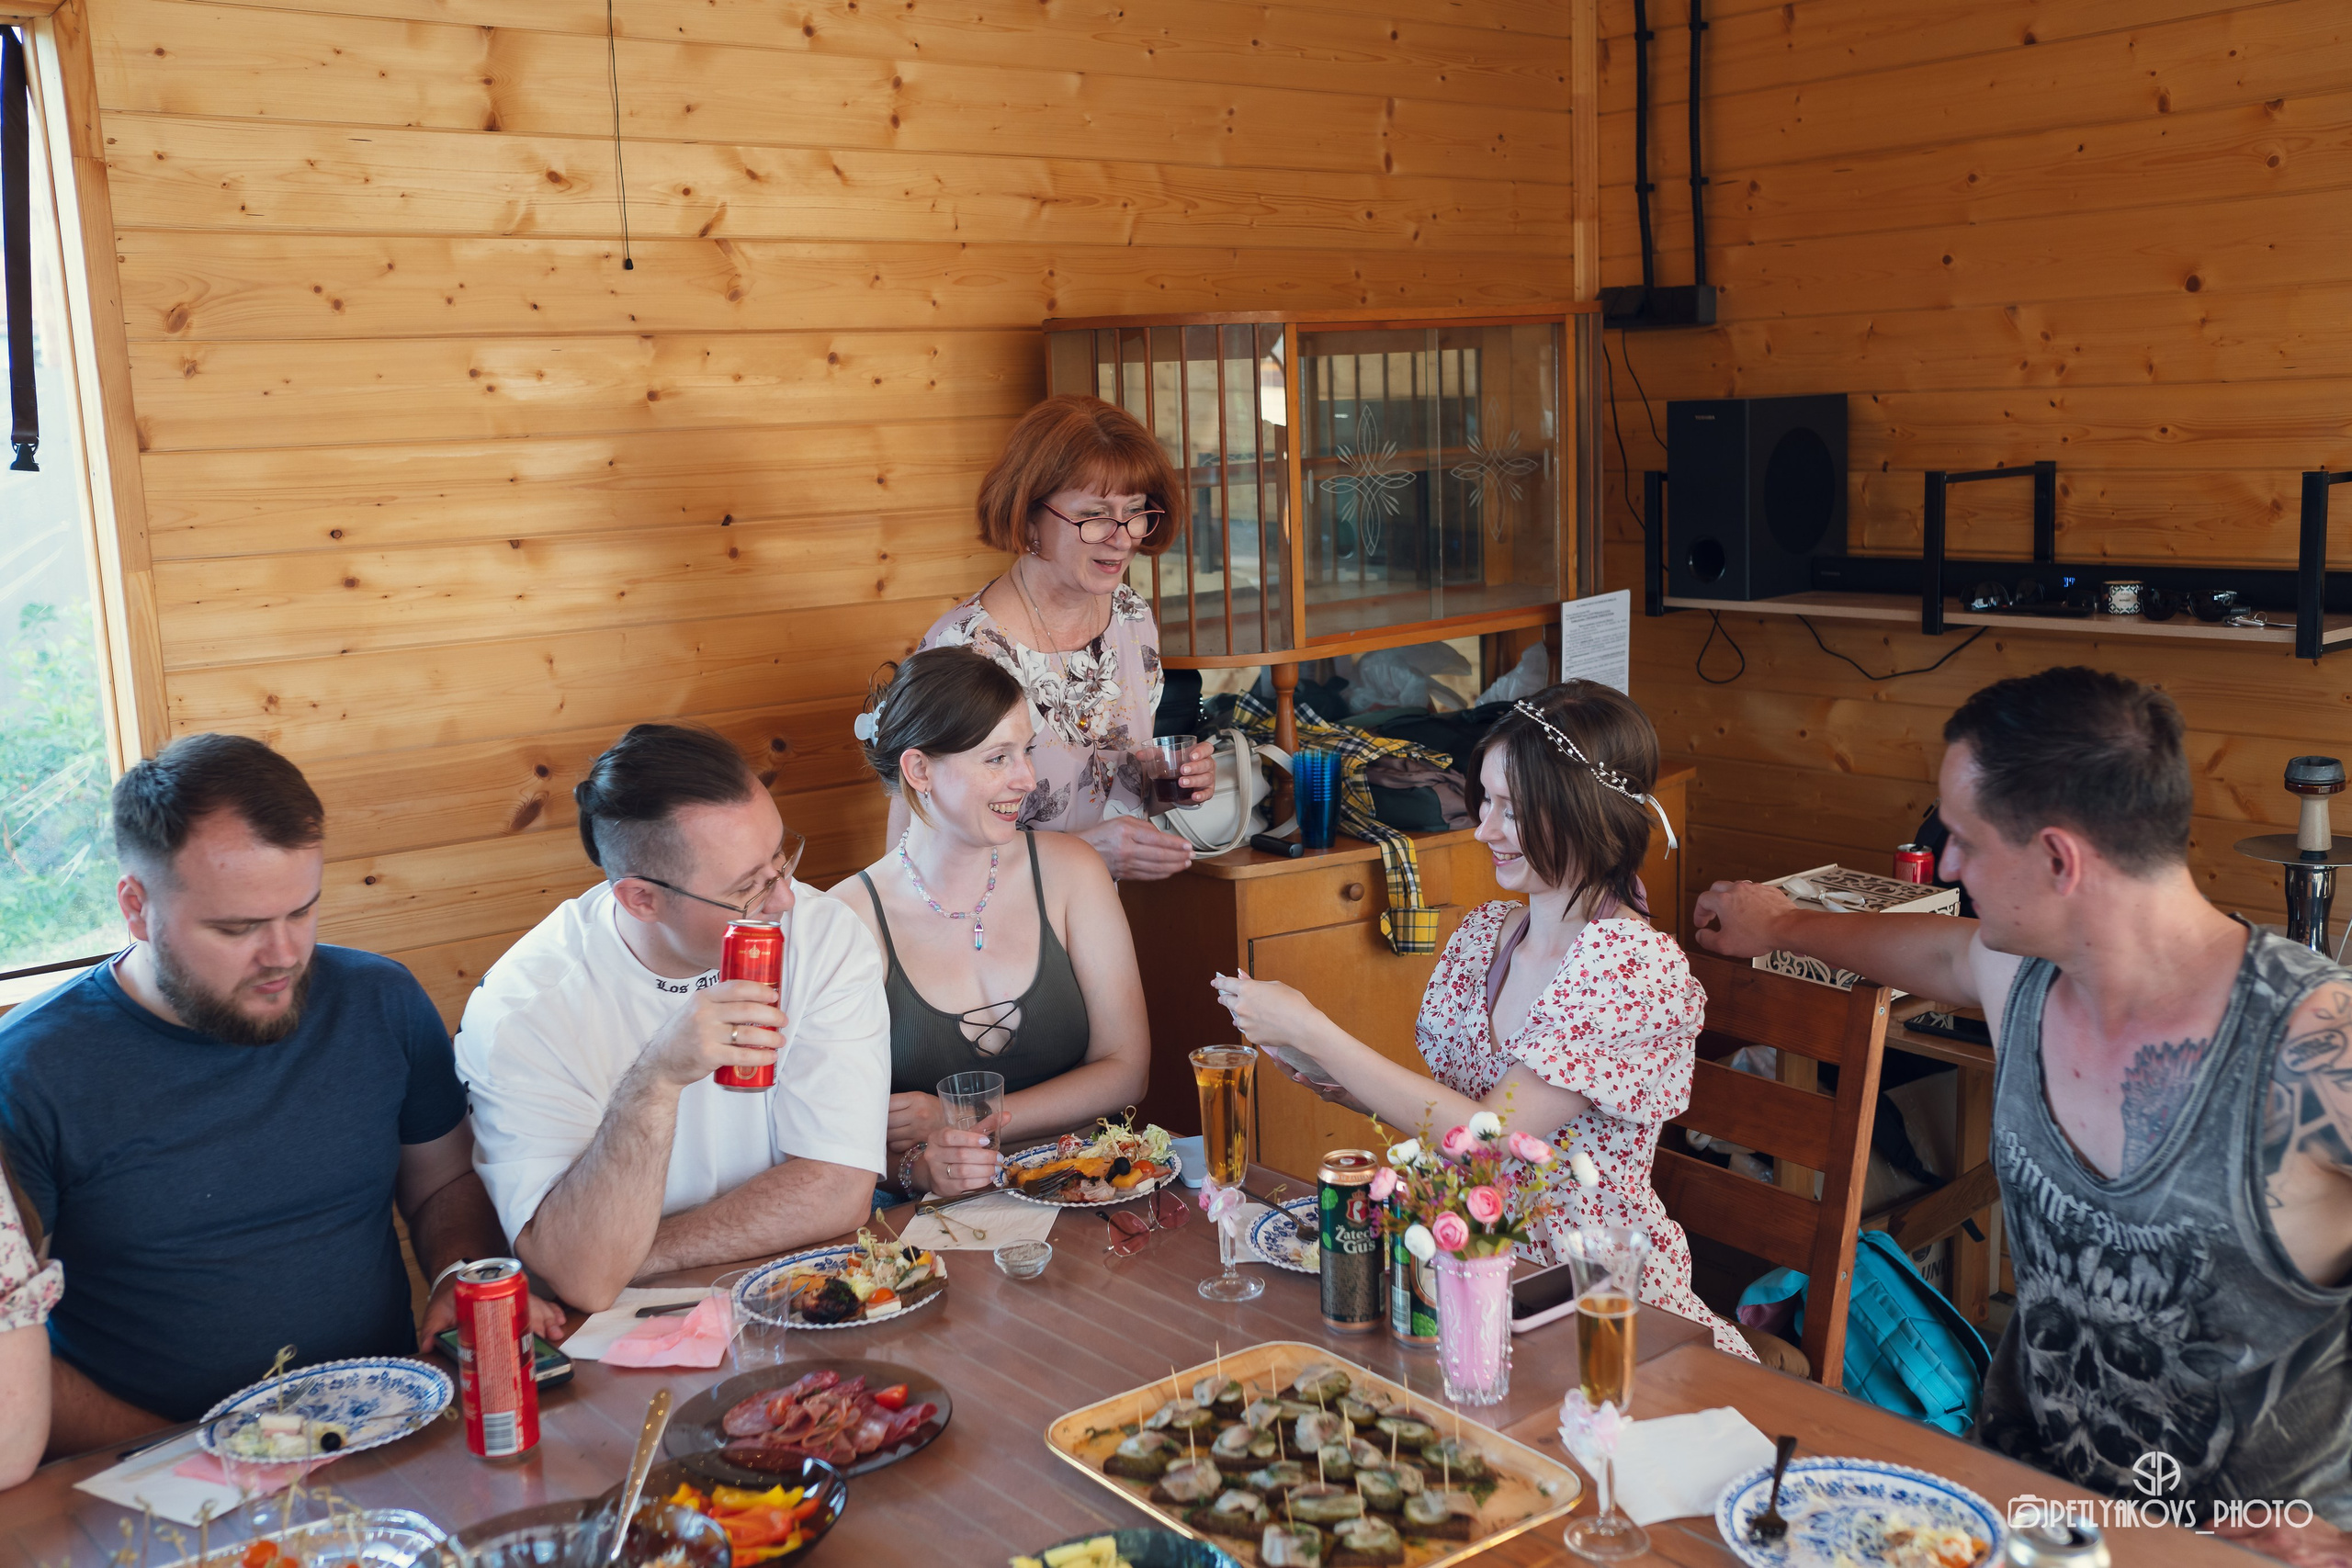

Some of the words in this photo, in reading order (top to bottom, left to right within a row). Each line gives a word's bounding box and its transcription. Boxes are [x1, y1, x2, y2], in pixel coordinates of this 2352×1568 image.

[655, 978, 690, 994] Los
[695, 971, 721, 992] An
[1342, 1238, 1376, 1254] Gus
